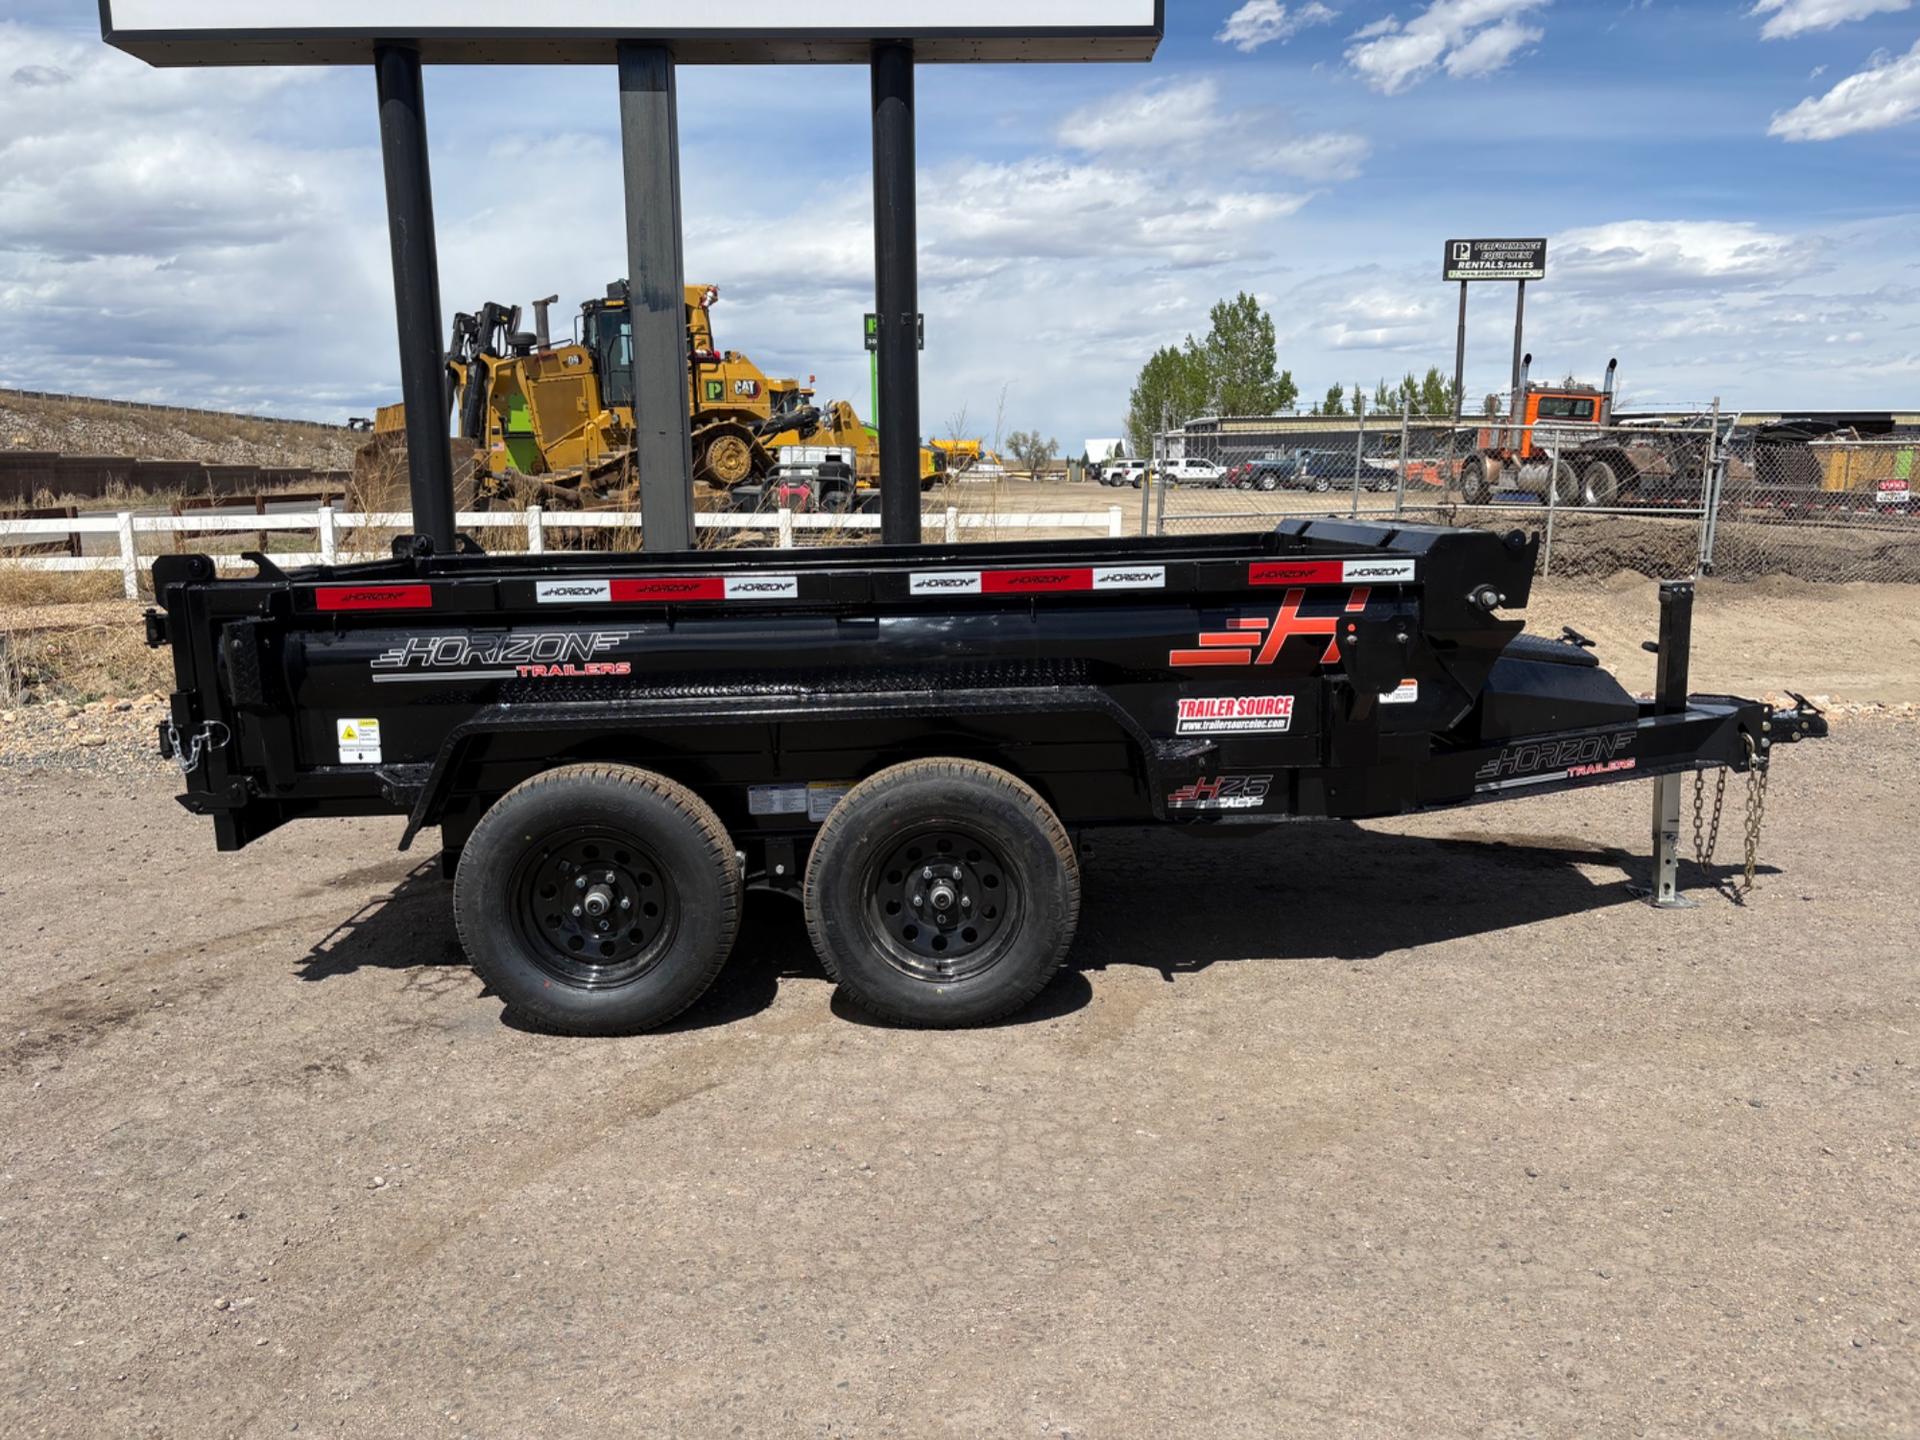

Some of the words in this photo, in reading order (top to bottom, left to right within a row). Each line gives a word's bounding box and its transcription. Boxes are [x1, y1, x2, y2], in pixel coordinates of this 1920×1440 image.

[1480, 251, 1534, 260] EQUIPMENT
[1458, 261, 1534, 269] RENTALS/SALES
[735, 380, 755, 395] CAT
[1253, 569, 1318, 579] HORIZON
[1345, 567, 1411, 577] HORIZON
[914, 578, 978, 588] HORIZON
[1007, 575, 1071, 585] HORIZON
[1098, 573, 1163, 583] HORIZON
[541, 586, 607, 596] HORIZON
[635, 584, 702, 594] HORIZON
[729, 582, 795, 592] HORIZON
[341, 592, 405, 602] HORIZON
[370, 631, 629, 668] HORIZON
[516, 663, 631, 677] TRAILERS
[1180, 700, 1235, 717] TRAILER
[1237, 697, 1293, 715] SOURCE
[1181, 719, 1286, 731] www.trailersourceinc.com
[1475, 731, 1637, 779] HORIZON
[1567, 757, 1636, 777] TRAILERS
